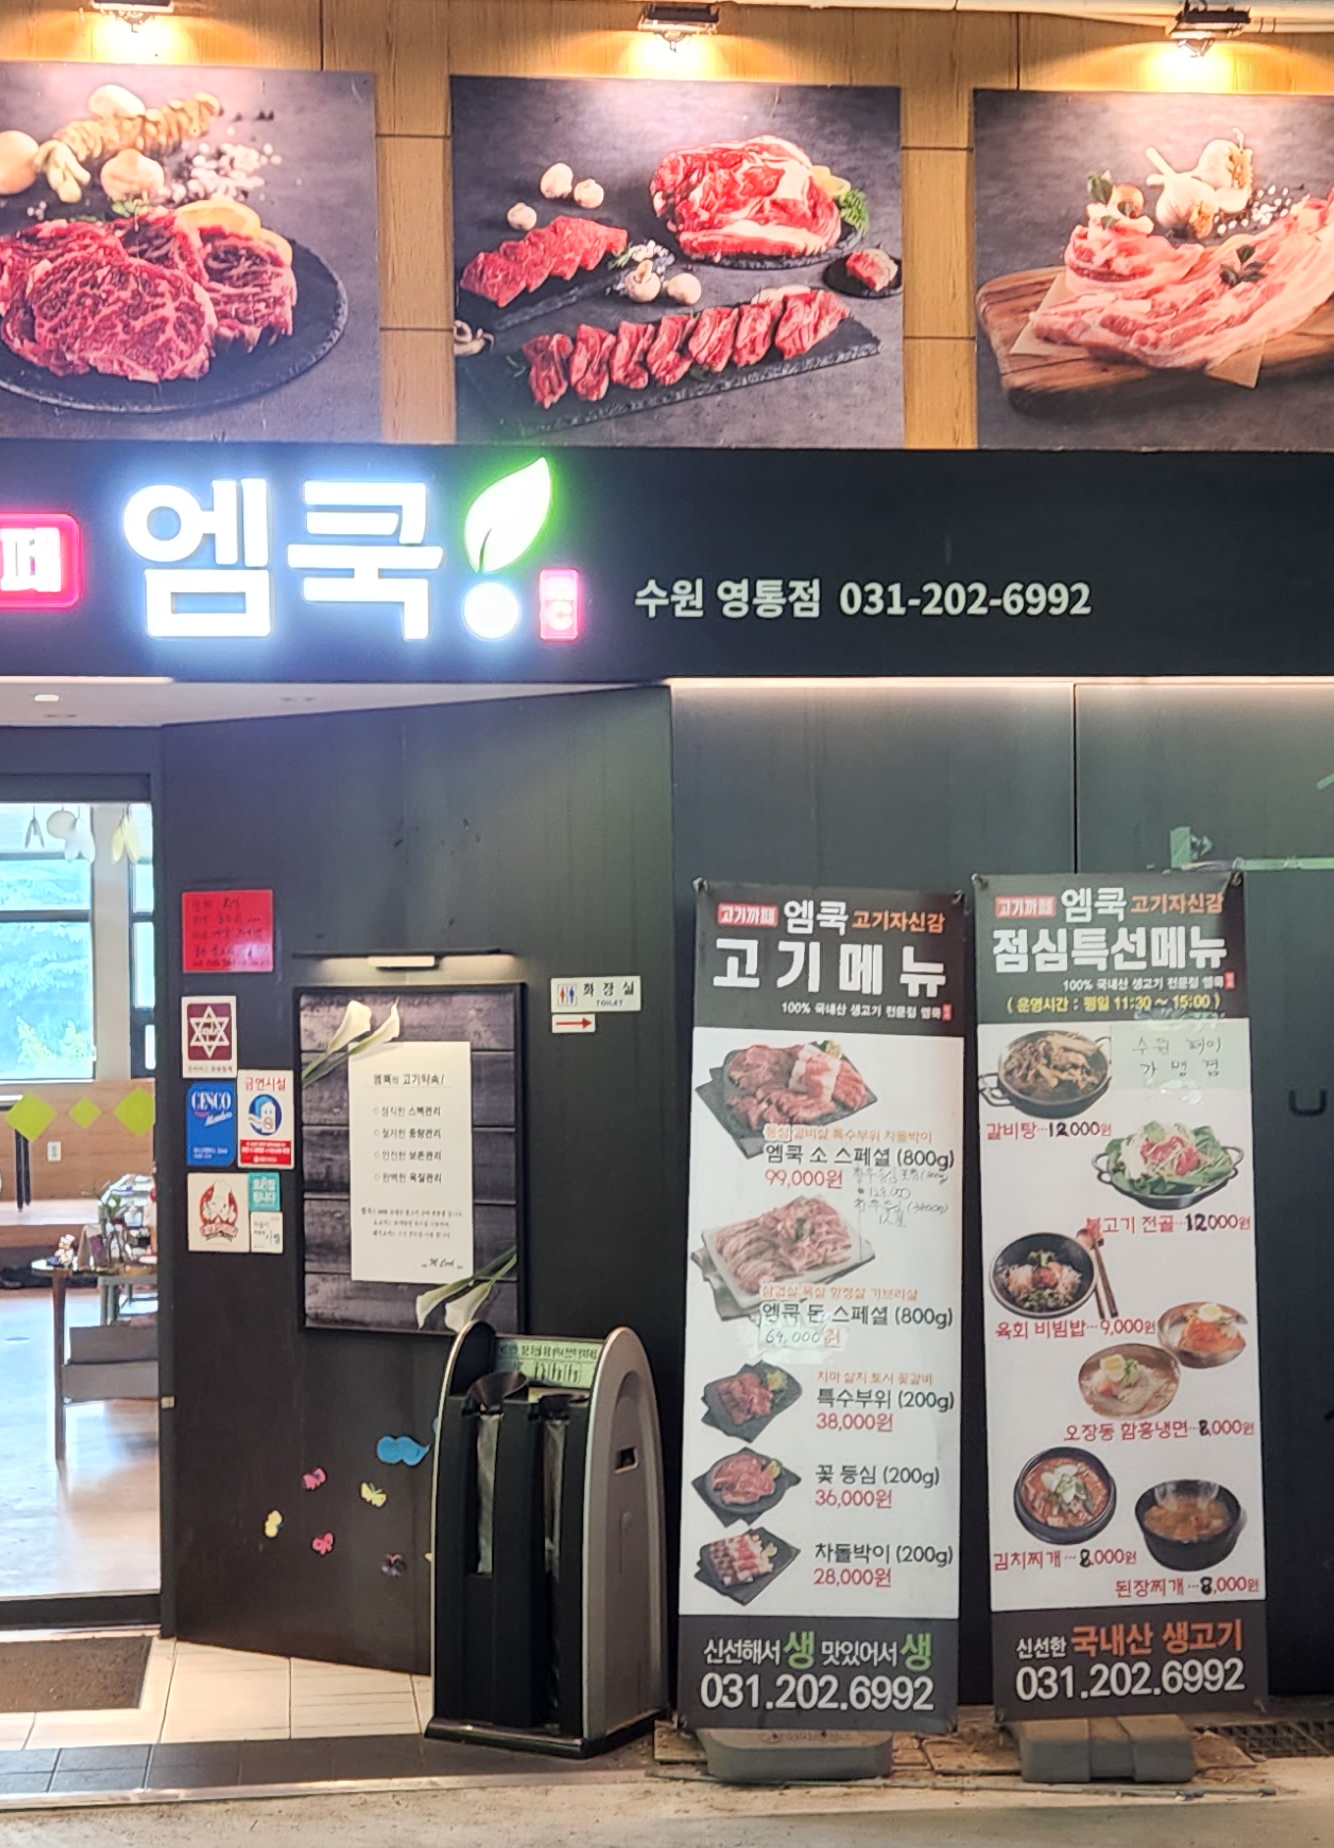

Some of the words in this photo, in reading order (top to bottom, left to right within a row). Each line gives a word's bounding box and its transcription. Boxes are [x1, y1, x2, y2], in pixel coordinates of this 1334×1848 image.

[633, 577, 705, 618] 수원
[715, 576, 822, 619] 영통점
[837, 579, 1093, 618] 031-202-6992
[1060, 887, 1128, 923] 엠쿡
[1130, 893, 1225, 915] 고기자신감
[783, 899, 849, 936] 엠쿡
[851, 910, 946, 934] 고기자신감
[992, 925, 1228, 973] 점심특선메뉴
[1063, 979, 1094, 992] 100%
[781, 1001, 811, 1014] 100%
[1016, 996, 1069, 1013] 운영시간
[1083, 995, 1110, 1012] 평일
[1172, 993, 1210, 1008] 15:00
[244, 1076, 286, 1092] 금연시설
[986, 1122, 1037, 1141] 갈비탕
[765, 1143, 804, 1164] 엠쿡
[809, 1147, 828, 1164] 소
[834, 1147, 890, 1167] 스페셜
[896, 1149, 956, 1172] (800g)
[764, 1168, 844, 1190] 99,000원
[1085, 1216, 1136, 1235] 불고기
[1141, 1214, 1175, 1233] 전골
[807, 1303, 824, 1324] 돈
[831, 1303, 889, 1326] 스페셜
[894, 1306, 954, 1329] (800g)
[995, 1321, 1029, 1341] 육회
[1034, 1319, 1087, 1339] 비빔밥
[1099, 1318, 1156, 1337] 9,000원
[817, 1387, 892, 1410] 특수부위
[897, 1390, 955, 1413] (200g)
[815, 1412, 894, 1433] 38,000원
[1063, 1424, 1115, 1442] 오장동
[1120, 1421, 1190, 1441] 함흥냉면
[815, 1464, 835, 1485] 꽃
[839, 1464, 877, 1485] 등심
[882, 1465, 941, 1489] (200g)
[815, 1489, 893, 1509] 36,000원
[814, 1542, 891, 1565] 차돌박이
[895, 1545, 955, 1568] (200g)
[993, 1549, 1062, 1571] 김치찌개
[813, 1567, 892, 1588] 28,000원
[1115, 1577, 1185, 1598] 된장찌개
[1016, 1636, 1067, 1660] 신선한
[1071, 1622, 1153, 1658] 국내산
[1162, 1618, 1244, 1655] 생고기
[703, 1638, 781, 1666] 신선해서
[783, 1630, 815, 1670] 생
[821, 1639, 898, 1667] 맛있어서
[900, 1632, 933, 1672] 생
[1015, 1656, 1246, 1702] 031.202.6992
[699, 1671, 935, 1712] 031.202.6992
